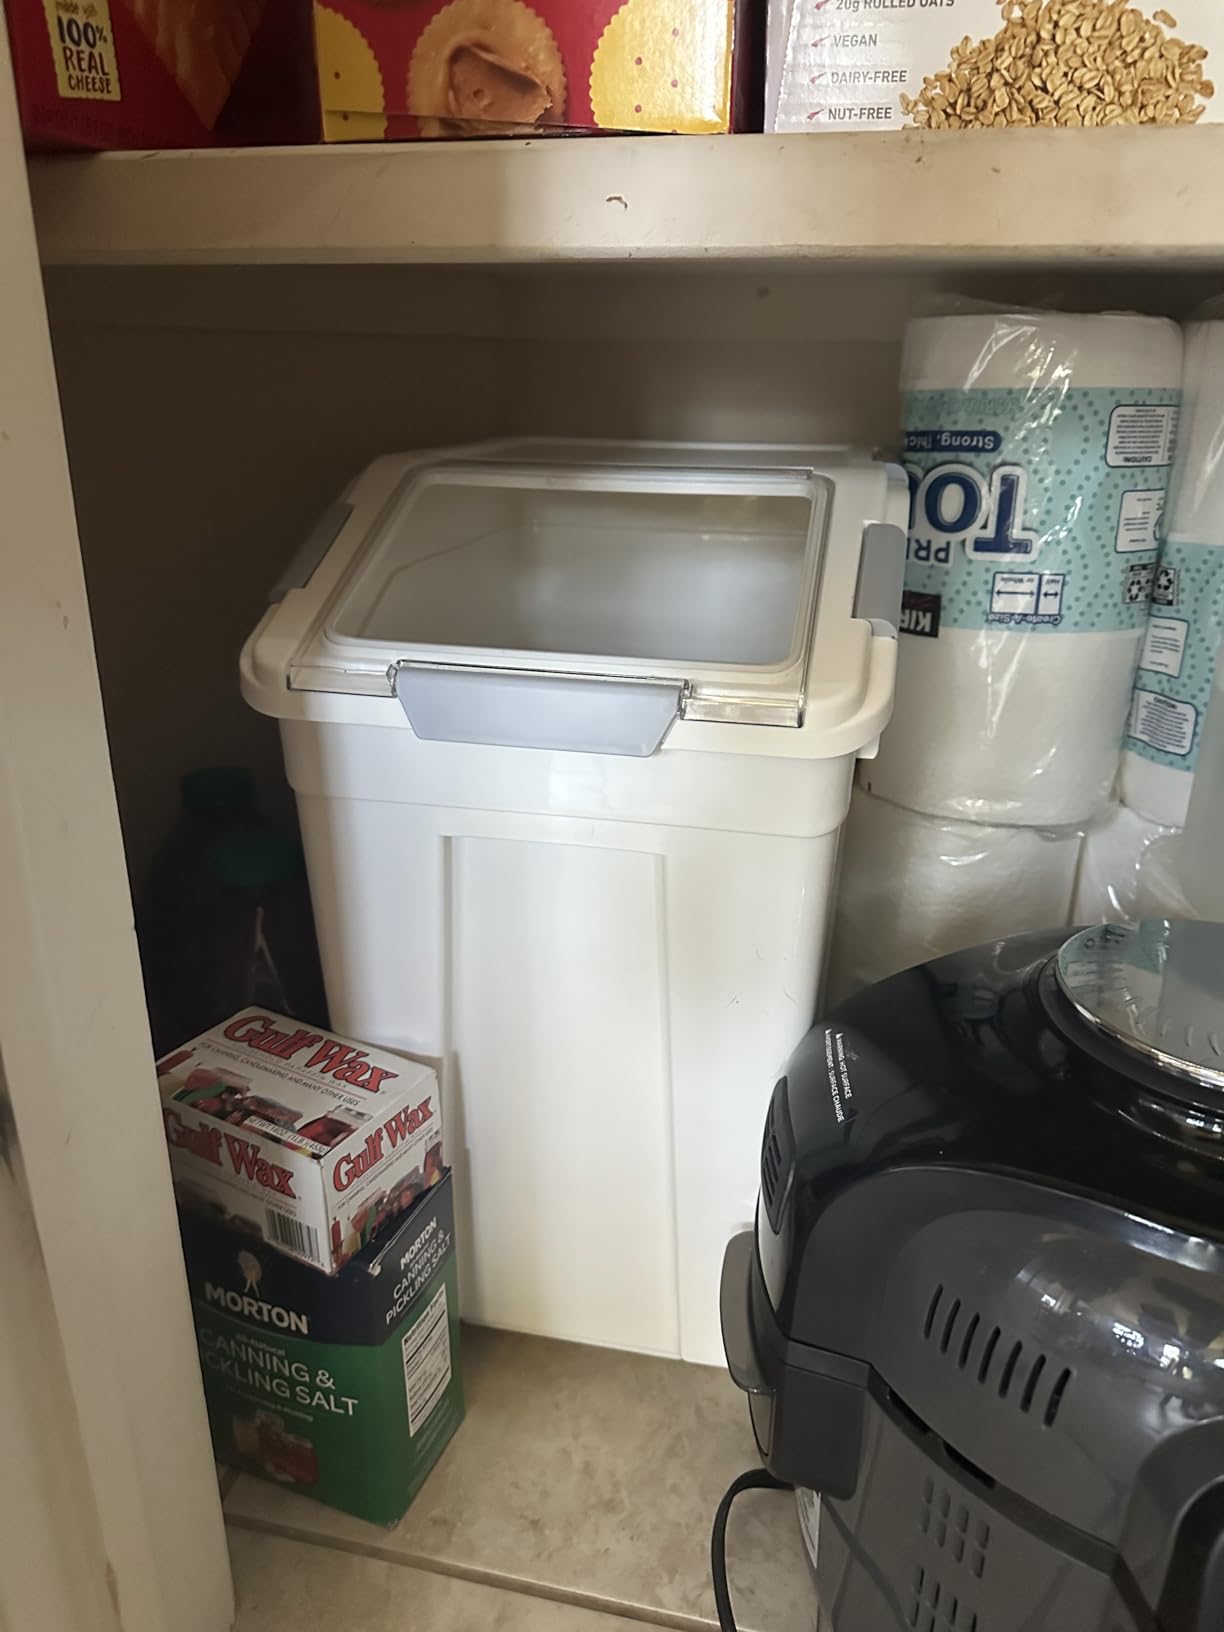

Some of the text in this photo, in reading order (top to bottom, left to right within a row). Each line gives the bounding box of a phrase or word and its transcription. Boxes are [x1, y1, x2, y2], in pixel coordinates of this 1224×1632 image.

[57, 16, 108, 49] 100%
[833, 33, 878, 48] VEGAN
[63, 46, 110, 76] REAL
[831, 70, 908, 84] DAIRY-FREE
[68, 74, 112, 94] CHEESE
[828, 107, 893, 121] NUT-FREE
[936, 432, 995, 450] Strong,
[224, 1015, 399, 1093] Gulf Wax
[833, 1096, 845, 1122] CHAUDE
[333, 1127, 384, 1192] Gulf
[384, 1096, 434, 1149] Wax
[224, 1132, 297, 1199] Wax
[400, 1216, 438, 1271] MORTON
[385, 1263, 432, 1325] PICKLING
[432, 1231, 451, 1268] SALT
[393, 1239, 438, 1299] CANNING
[204, 1281, 309, 1336] MORTON
[315, 1368, 336, 1390] &
[295, 1385, 359, 1417] SALT
